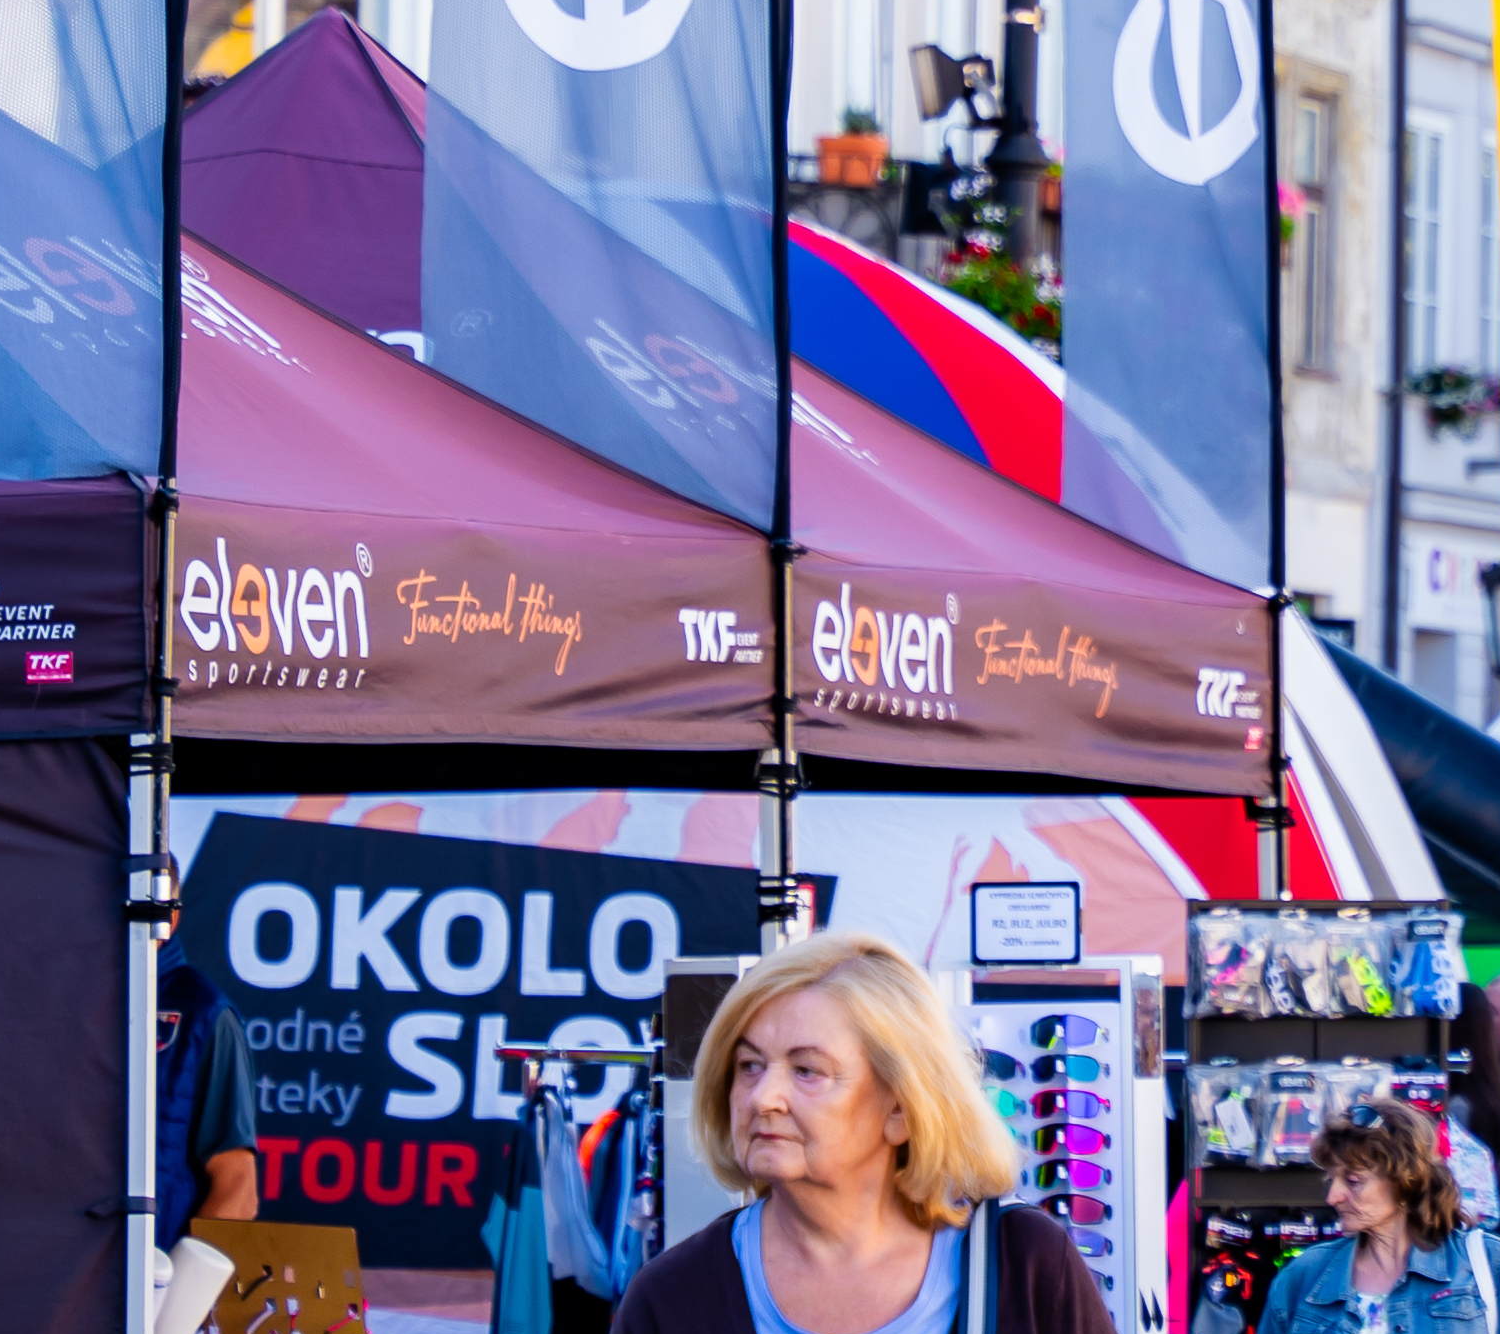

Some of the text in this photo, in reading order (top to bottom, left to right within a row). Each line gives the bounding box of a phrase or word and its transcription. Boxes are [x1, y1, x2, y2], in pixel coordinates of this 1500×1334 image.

[397, 569, 582, 676] Functional things
[679, 609, 736, 662] TKF
[29, 654, 70, 670] TKF
[187, 660, 366, 690] sportswear
[228, 883, 681, 999] OKOLO
[256, 1073, 361, 1126] teky
[255, 1136, 480, 1207] TOUR
